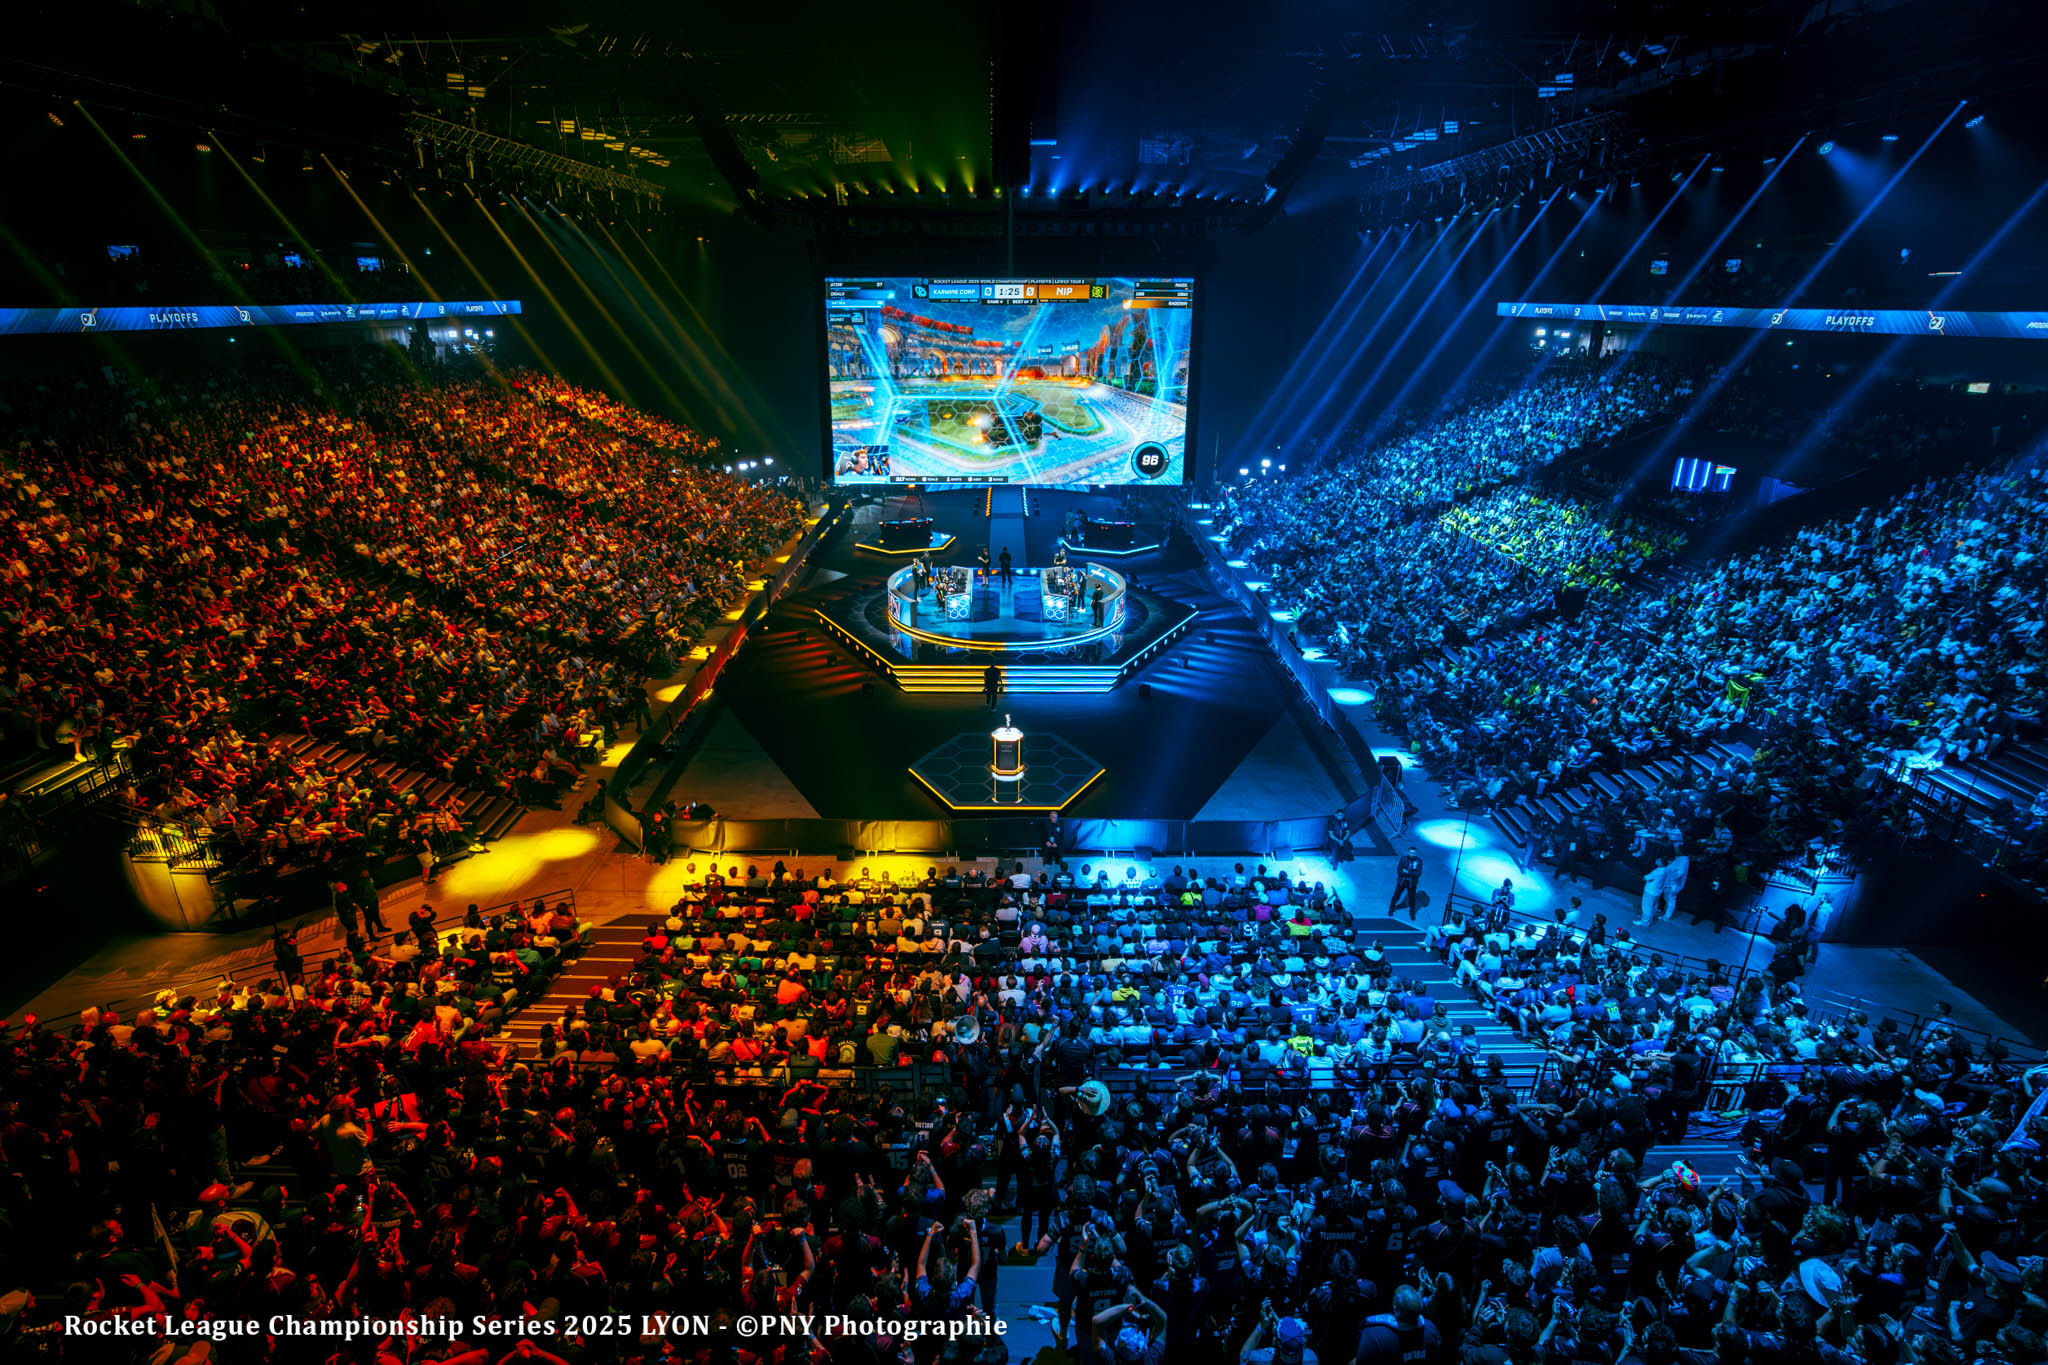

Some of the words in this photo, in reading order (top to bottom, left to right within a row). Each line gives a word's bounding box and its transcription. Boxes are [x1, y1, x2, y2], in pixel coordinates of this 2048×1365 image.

[999, 288, 1020, 296] 1:25
[1056, 287, 1073, 296] NIP
[149, 312, 198, 323] PLAYOFFS
[1825, 315, 1875, 326] PLAYOFFS
[1142, 455, 1159, 466] 96
